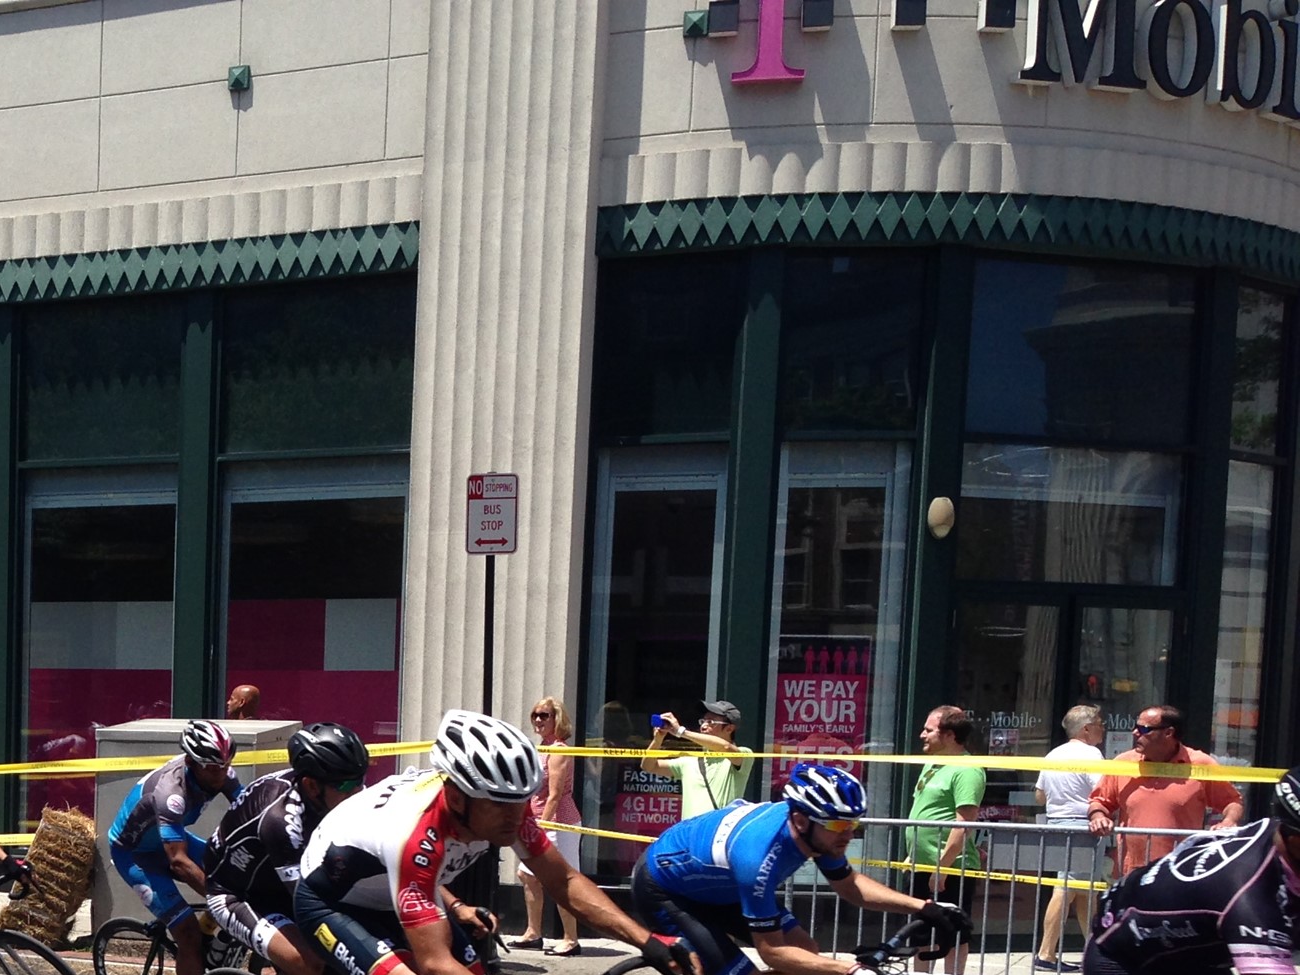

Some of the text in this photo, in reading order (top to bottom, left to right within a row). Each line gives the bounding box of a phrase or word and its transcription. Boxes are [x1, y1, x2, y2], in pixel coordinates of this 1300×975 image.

[469, 480, 513, 495] NO STOPPING
[483, 504, 502, 515] BUS
[480, 520, 504, 531] STOP
[784, 680, 859, 698] WE PAY
[783, 699, 857, 723] YOUR
[990, 710, 1036, 728] Mobile
[782, 724, 856, 734] FAMILY'S EARLY
[1107, 713, 1137, 730] Mob
[779, 745, 855, 773] FEES
[623, 783, 680, 793] NATIONWIDE
[622, 796, 679, 813] 4G LTE
[621, 812, 678, 824] NETWORK
